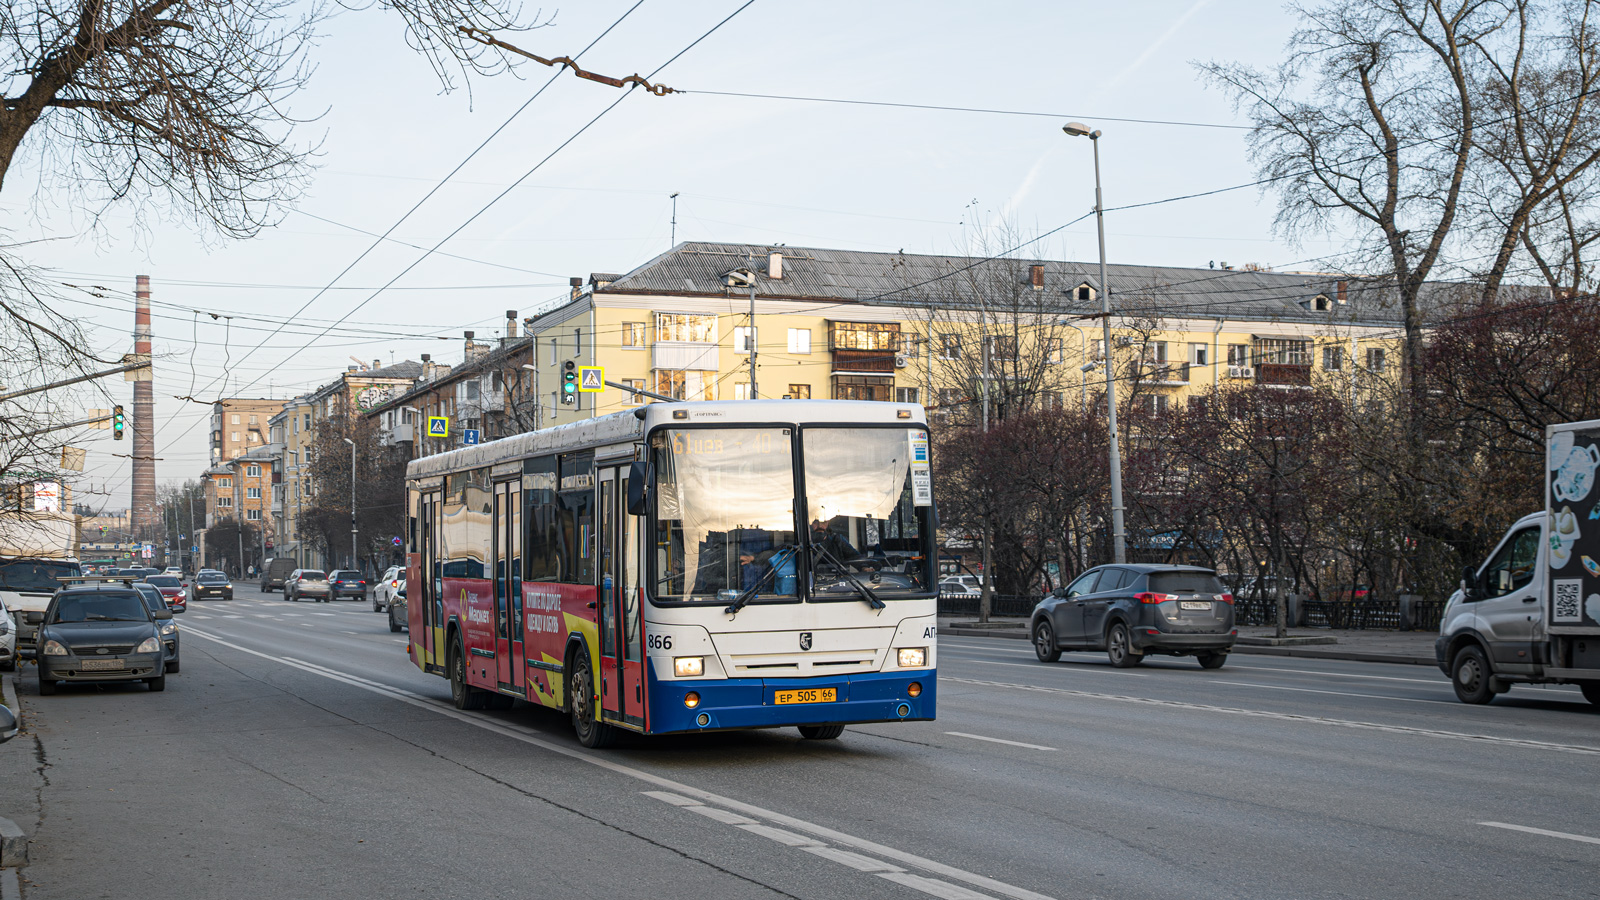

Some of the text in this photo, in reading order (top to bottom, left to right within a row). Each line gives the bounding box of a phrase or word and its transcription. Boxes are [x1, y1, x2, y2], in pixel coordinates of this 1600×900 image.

[468, 606, 490, 625] Маркет
[648, 633, 673, 650] 866
[797, 690, 817, 702] 505
[822, 689, 833, 698] 66
